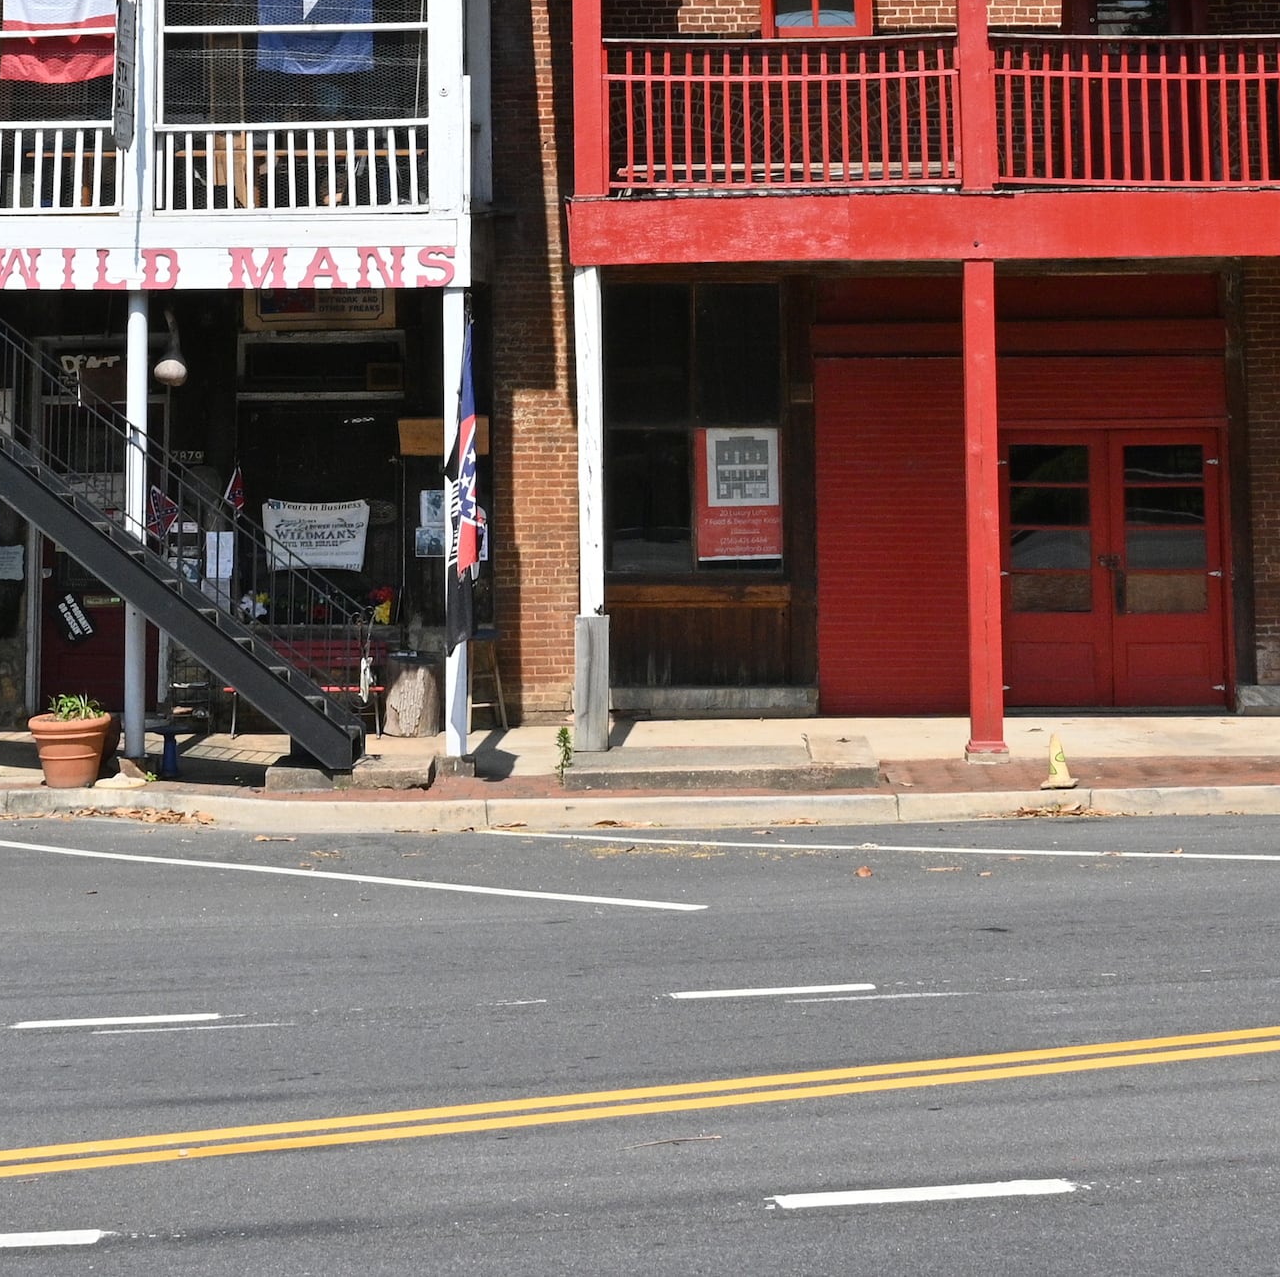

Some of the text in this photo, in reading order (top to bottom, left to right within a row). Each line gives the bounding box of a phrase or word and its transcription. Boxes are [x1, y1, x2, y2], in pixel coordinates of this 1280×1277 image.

[228, 246, 456, 289] MANS
[348, 304, 381, 312] FREAKS
[282, 502, 307, 511] Years
[321, 502, 362, 511] Business
[58, 603, 68, 613] OR
[64, 593, 74, 604] NO
[70, 603, 93, 634] PROFANITY
